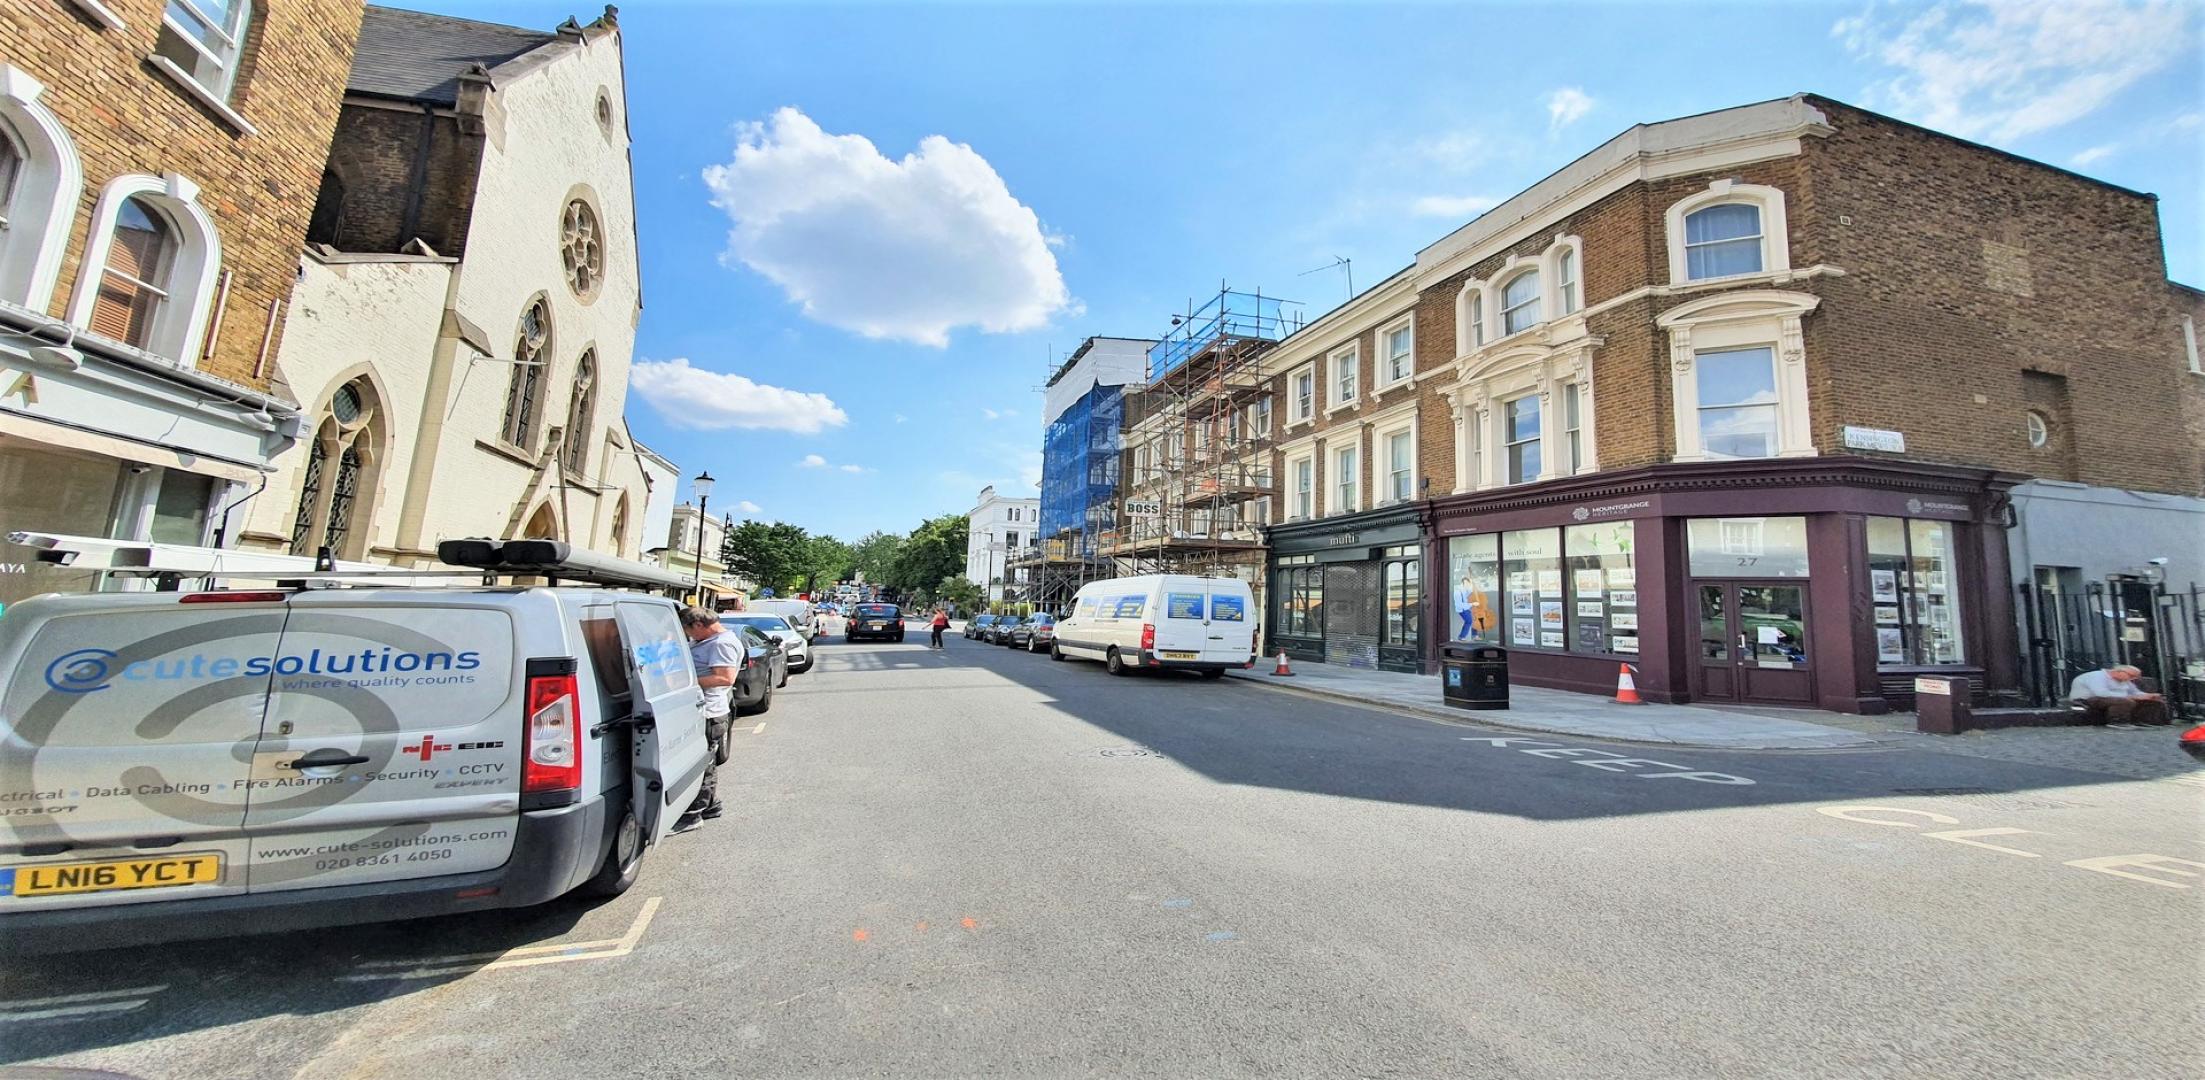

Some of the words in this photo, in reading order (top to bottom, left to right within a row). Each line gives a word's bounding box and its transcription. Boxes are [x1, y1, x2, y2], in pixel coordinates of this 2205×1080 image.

[1127, 503, 1159, 514] BOSS
[1592, 501, 1649, 513] MOUNTGRANGE
[1329, 533, 1355, 546] mufti
[1737, 558, 1758, 567] 27
[282, 677, 341, 690] where
[347, 675, 410, 688] quality
[416, 674, 475, 686] counts
[1460, 737, 1756, 785] KEEP
[86, 787, 131, 798] Data
[138, 782, 210, 795] Cabling
[233, 779, 269, 790] Fire
[275, 775, 344, 788] Alarms
[365, 768, 440, 781] Security
[459, 763, 504, 775] CCTV
[258, 830, 508, 859] www.cute-solutions.com
[316, 857, 350, 870] 020
[355, 854, 400, 868] 8361
[407, 849, 452, 863] 4050
[30, 866, 116, 890] LN16
[130, 860, 203, 883] YCT
